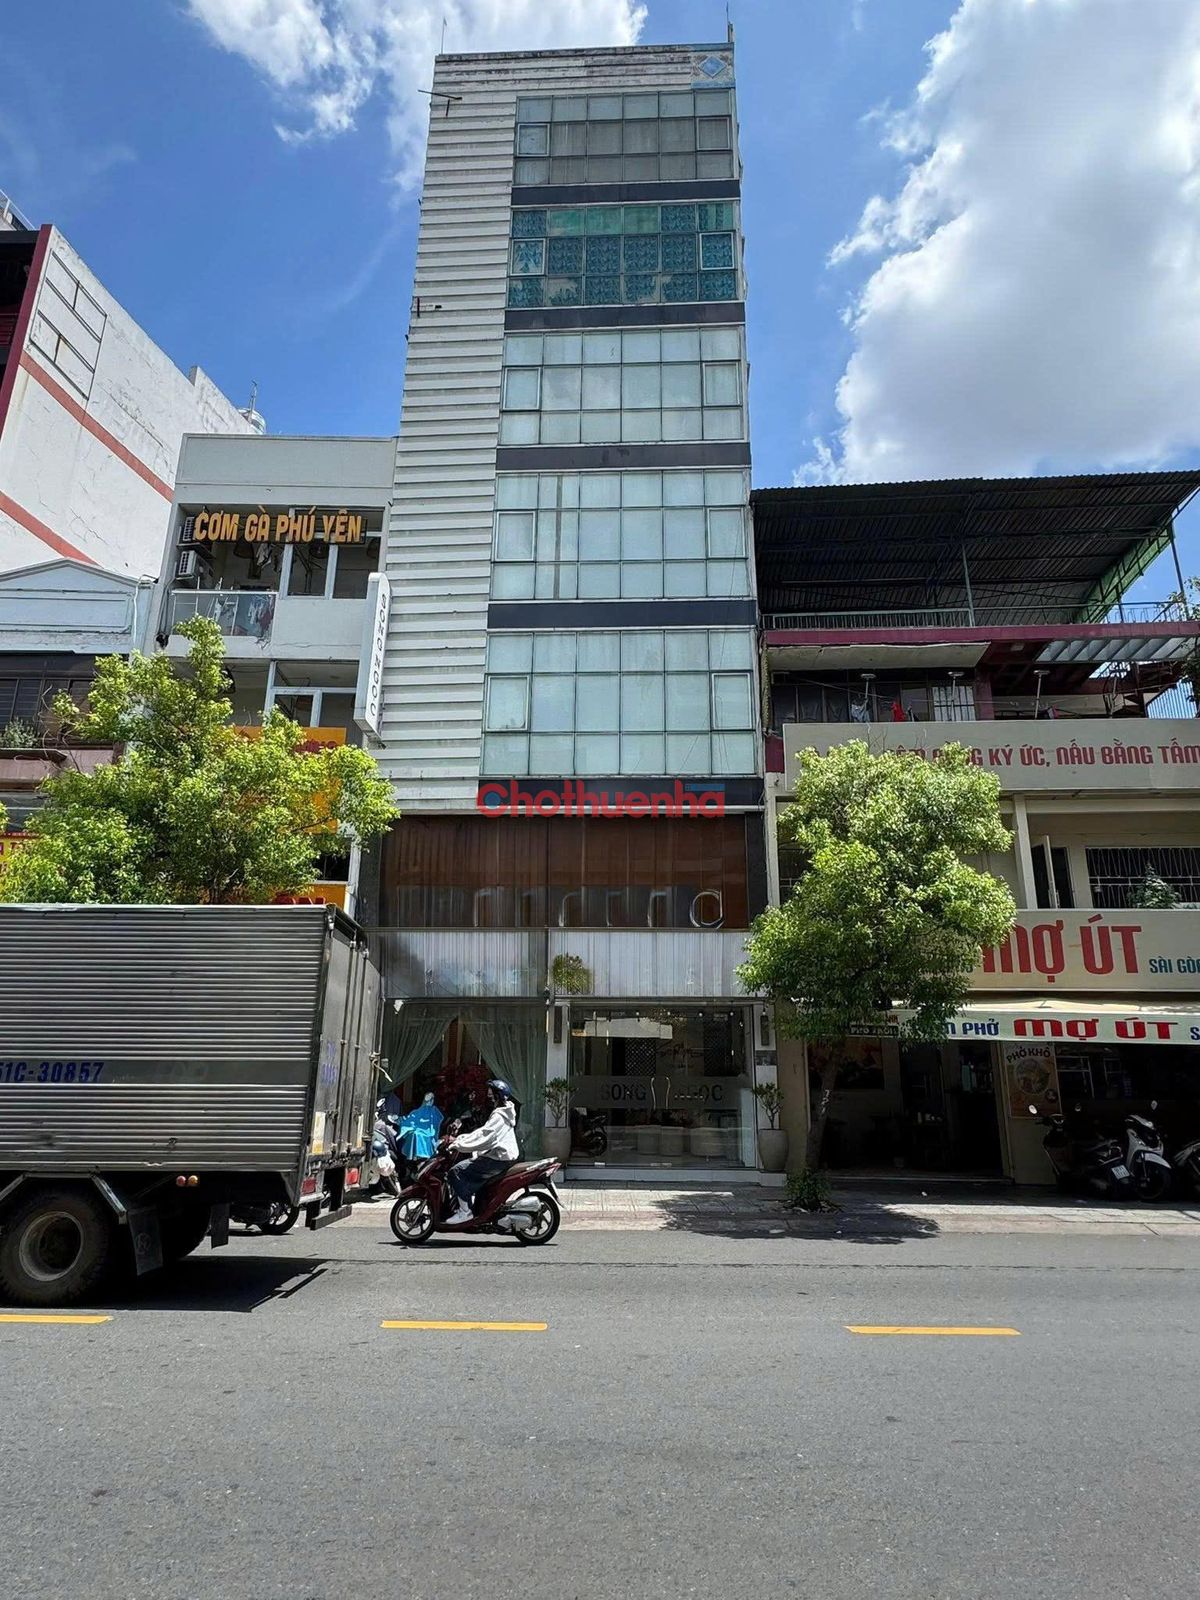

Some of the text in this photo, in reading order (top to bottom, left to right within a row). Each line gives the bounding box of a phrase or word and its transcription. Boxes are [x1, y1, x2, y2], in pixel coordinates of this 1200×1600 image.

[195, 505, 362, 543] CƠM GÀ PHÚ YÊN
[988, 744, 1013, 766] KÝ
[1056, 738, 1096, 765] NẤU
[1101, 738, 1154, 765] BẰNG
[1079, 913, 1142, 975] ÚT
[1149, 956, 1173, 974] SÀI
[1177, 956, 1200, 974] GÒ
[962, 1018, 1000, 1036] PHỞ
[1013, 1018, 1099, 1041] MỢ
[1115, 1017, 1178, 1040] ÚT
[1006, 1046, 1027, 1063] PHỞ
